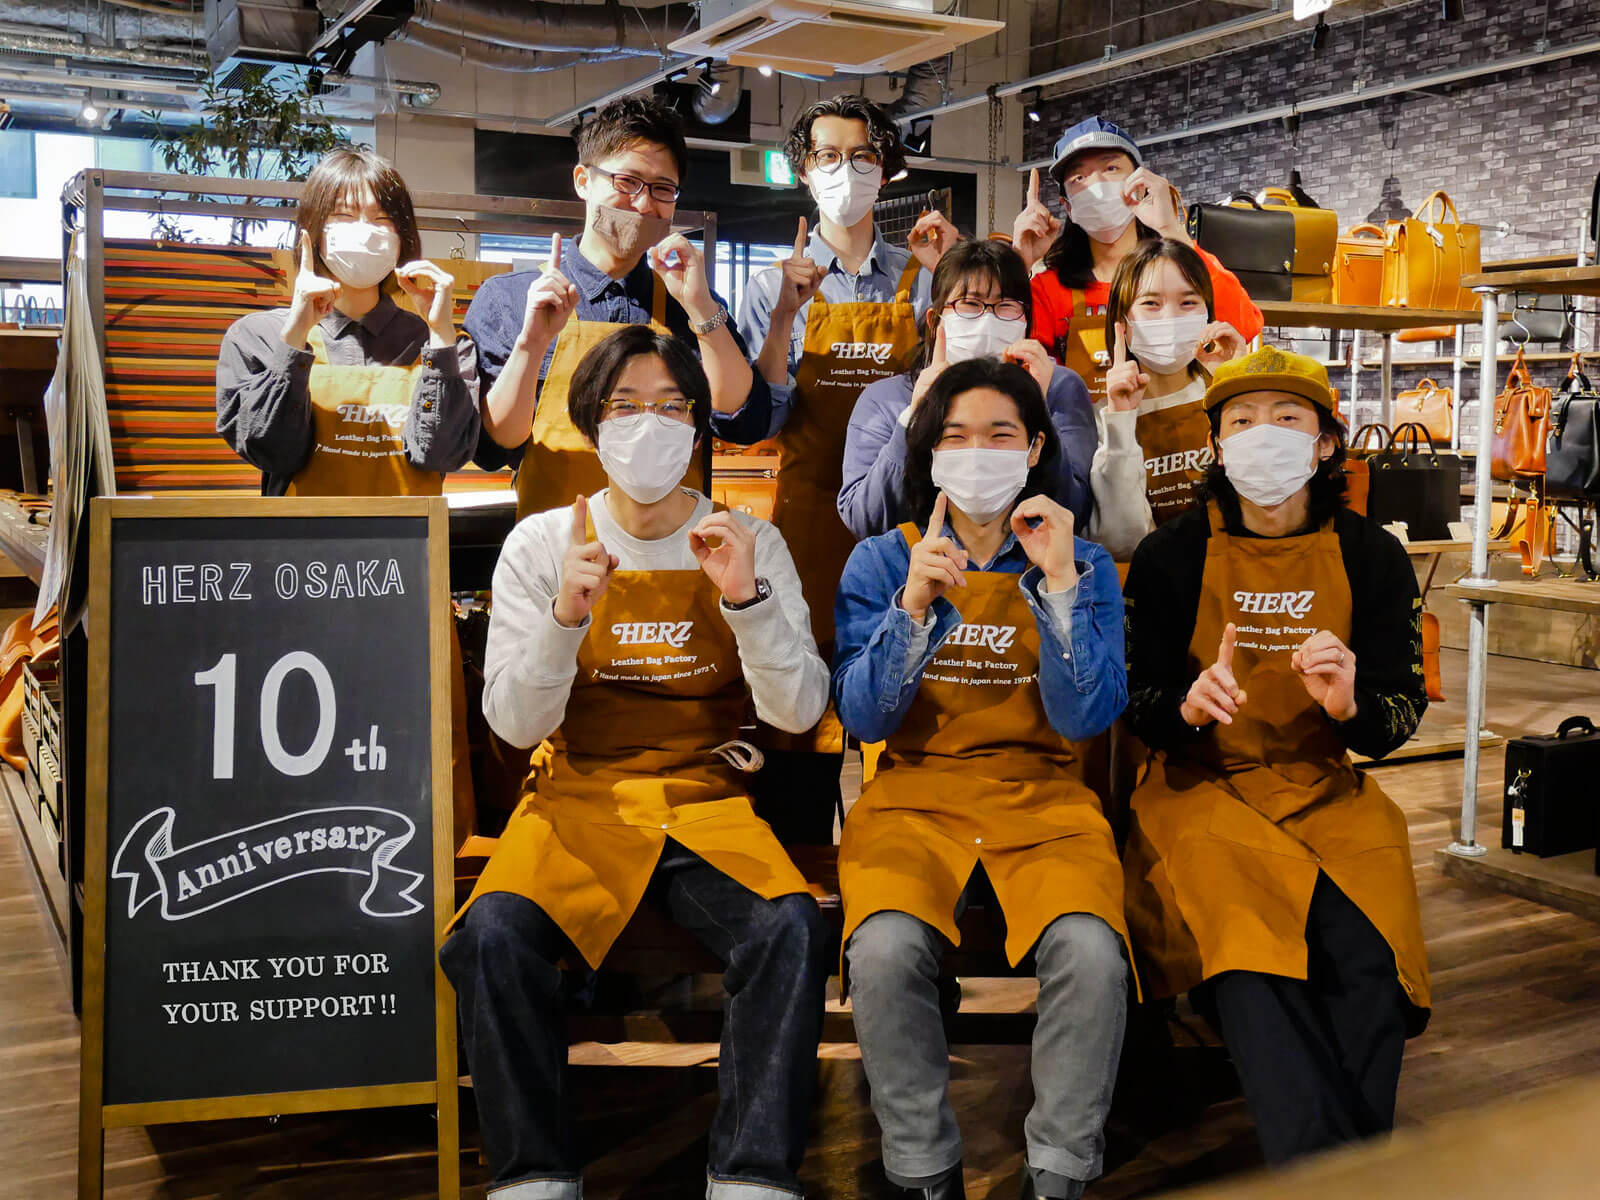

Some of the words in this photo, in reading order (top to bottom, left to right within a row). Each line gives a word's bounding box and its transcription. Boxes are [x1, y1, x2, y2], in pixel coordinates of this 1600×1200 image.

[831, 342, 893, 364] HERZ
[871, 369, 894, 377] Factory
[336, 404, 410, 428] HERZ
[335, 433, 364, 442] Leather
[366, 434, 380, 443] Bag
[1144, 446, 1214, 477] HERZ
[1148, 484, 1177, 496] Leather
[1177, 482, 1192, 490] Bag
[143, 562, 252, 605] HERZ
[275, 559, 405, 600] OSAKA
[1233, 591, 1316, 619] HERZ
[611, 621, 694, 648] HERZ
[1235, 625, 1264, 634] eather
[1265, 627, 1280, 636] Bag
[1283, 626, 1318, 636] Factory
[611, 657, 644, 667] Leather
[646, 656, 662, 666] Bag
[664, 654, 698, 664] Factory
[933, 657, 965, 667] Leather
[966, 659, 982, 669] Bag
[985, 660, 1018, 671] Factory
[599, 672, 619, 680] Hand
[673, 671, 692, 679] since
[940, 675, 959, 683] made
[961, 676, 968, 684] in
[1014, 675, 1031, 684] 1973
[177, 825, 386, 902] Anniversary
[163, 959, 260, 983] THANK
[267, 956, 325, 979] YOU
[334, 953, 390, 975] FOR
[162, 1002, 239, 1024] YOUR
[250, 994, 396, 1021] SUPPORT!!
